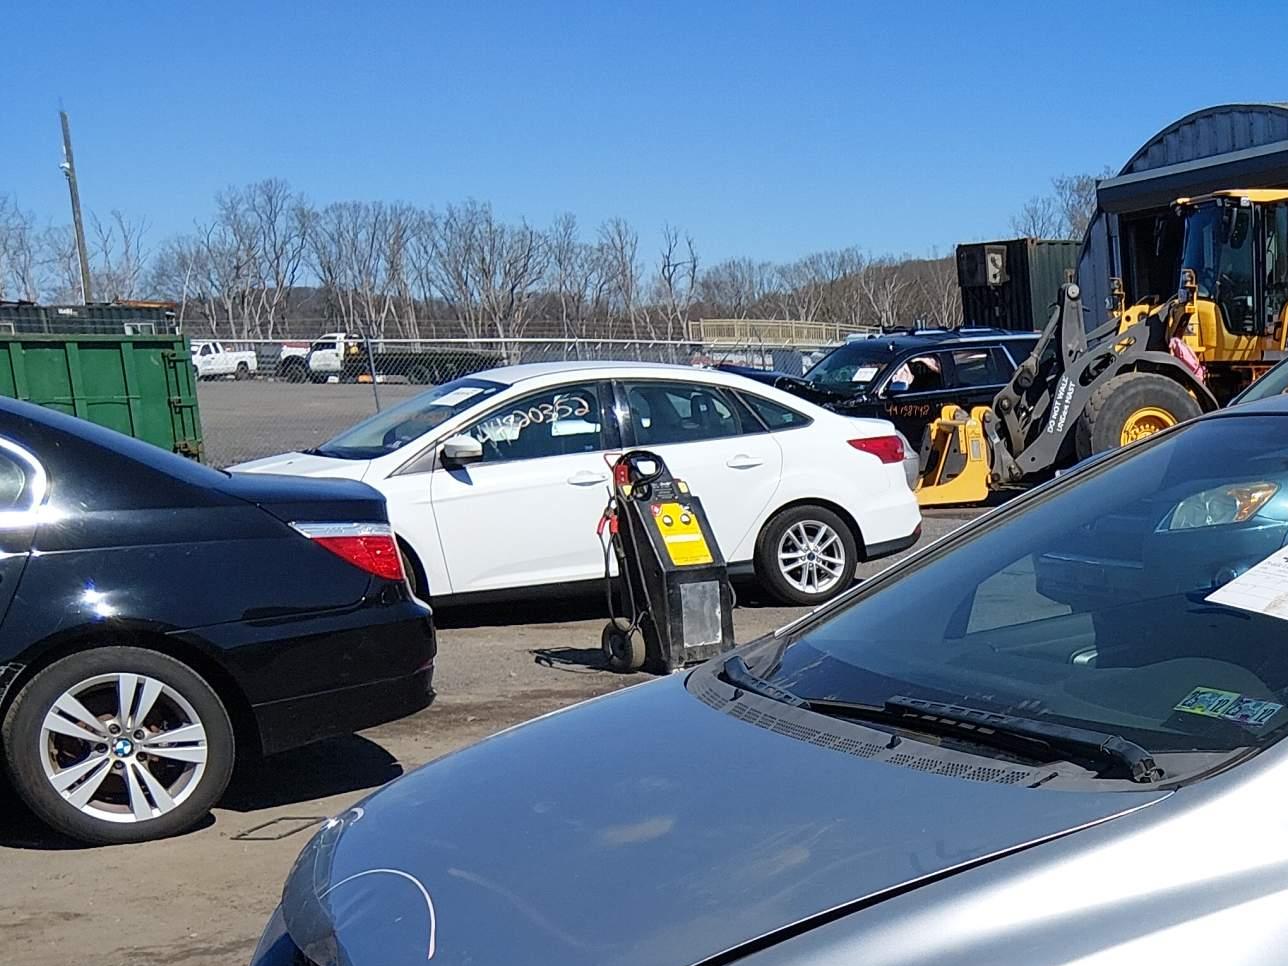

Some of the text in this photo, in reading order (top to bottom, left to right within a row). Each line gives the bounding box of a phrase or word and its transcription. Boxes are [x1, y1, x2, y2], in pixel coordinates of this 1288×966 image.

[1065, 381, 1076, 404] MAST
[1047, 420, 1056, 433] DO
[1052, 400, 1061, 420] NOT
